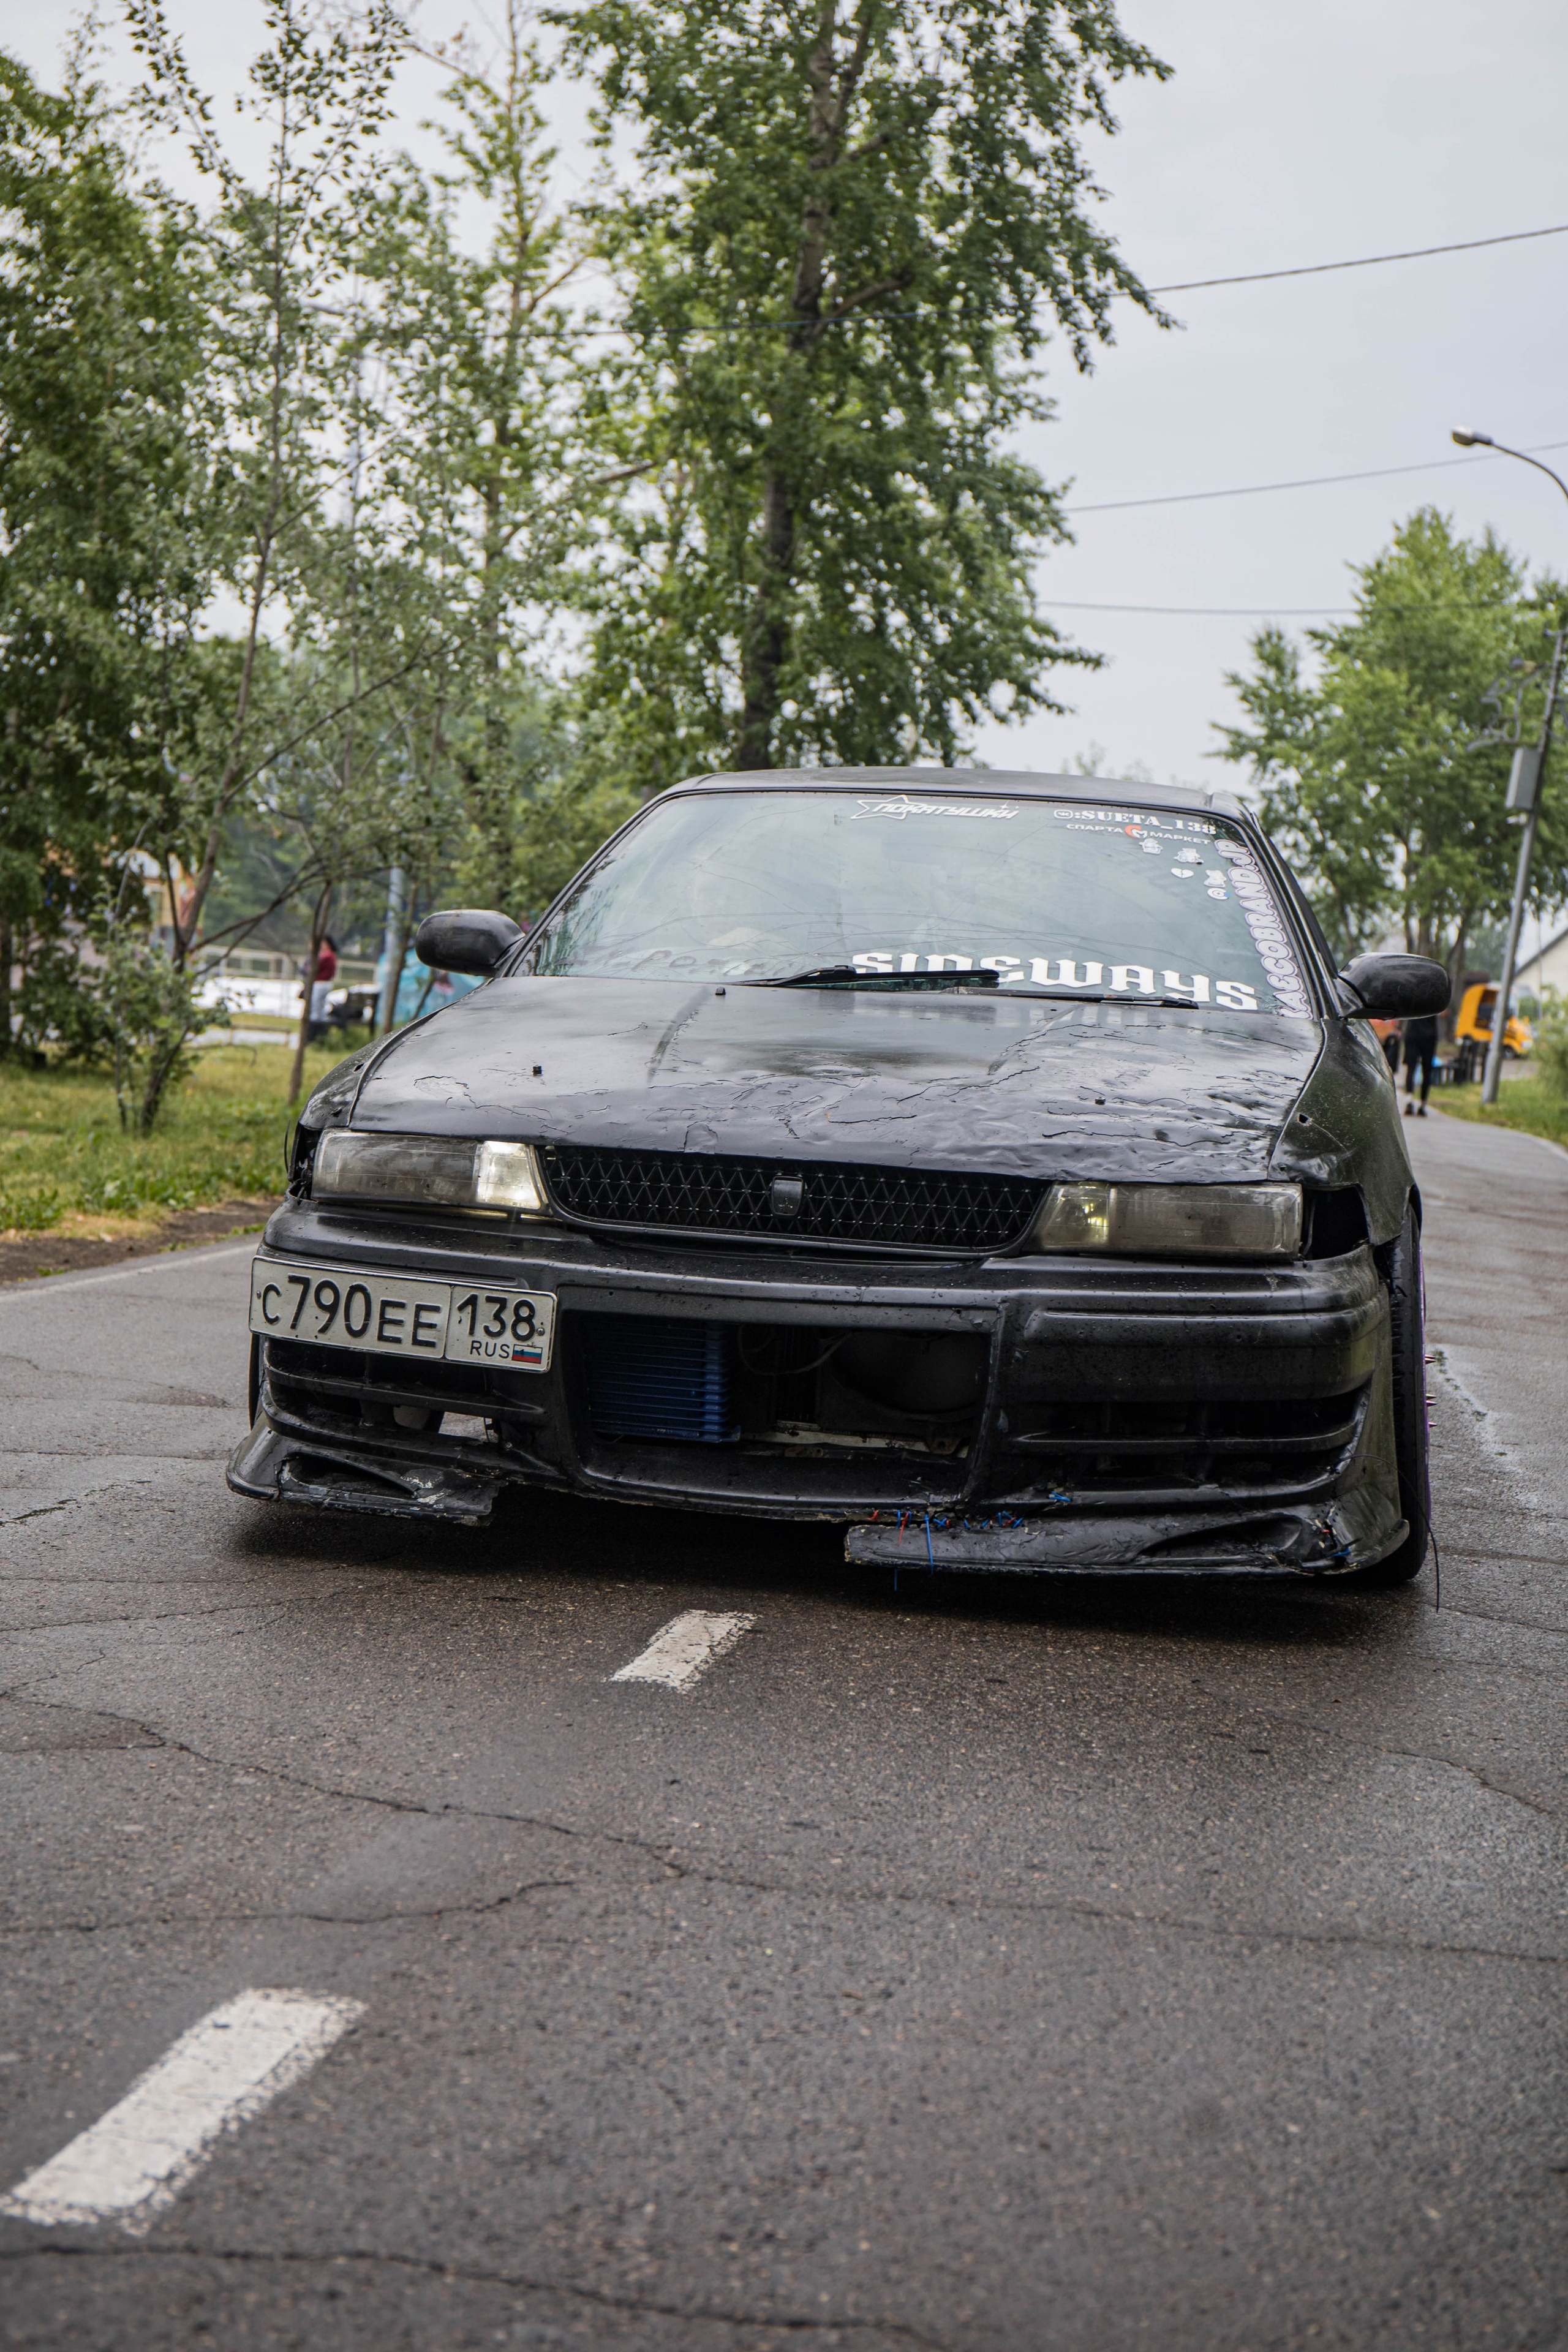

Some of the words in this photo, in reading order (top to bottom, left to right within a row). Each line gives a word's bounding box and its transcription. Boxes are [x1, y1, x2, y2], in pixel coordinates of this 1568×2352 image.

[1066, 824, 1123, 833] СПАРТА
[1150, 831, 1211, 845] МАРКЕТ
[456, 1294, 536, 1341] 138
[470, 1340, 510, 1359] RUS
